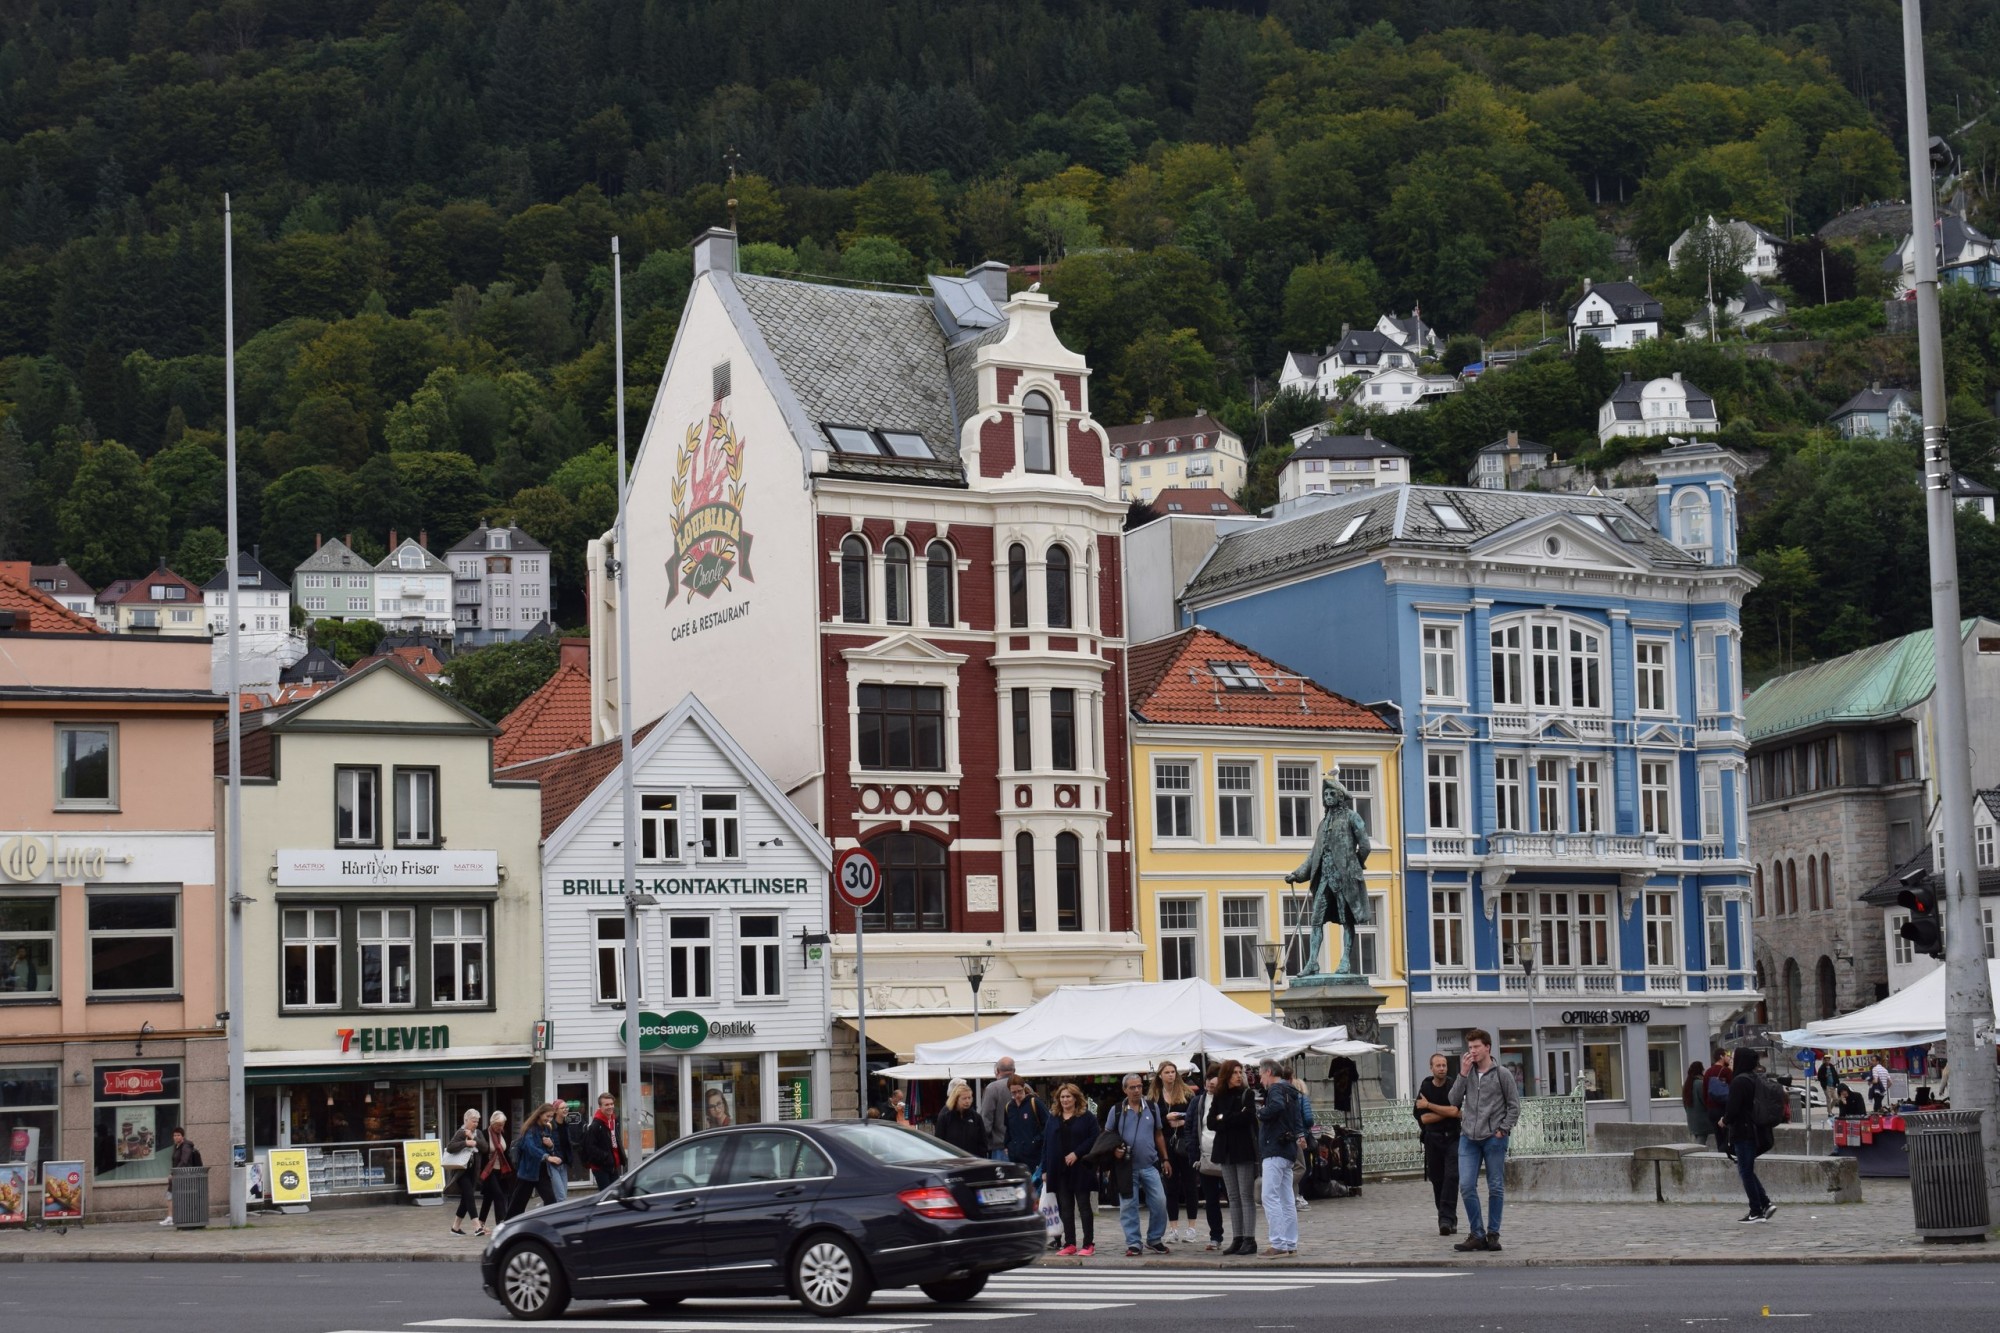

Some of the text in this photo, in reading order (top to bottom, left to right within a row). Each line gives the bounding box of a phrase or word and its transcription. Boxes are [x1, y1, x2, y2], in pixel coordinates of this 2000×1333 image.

[676, 507, 740, 557] LOUISIANA
[692, 558, 724, 590] Creole
[671, 600, 750, 641] CAFÉ & RESTAURANT
[52, 832, 106, 880] Luca
[402, 860, 439, 875] Frisør
[845, 861, 873, 890] 30
[638, 1020, 756, 1038] pecsavers Optikk
[1561, 1009, 1650, 1025] OPTIKER SVABØ
[115, 1076, 128, 1089] Deli
[140, 1075, 154, 1088] Luca
[793, 1082, 802, 1120] søkelse
